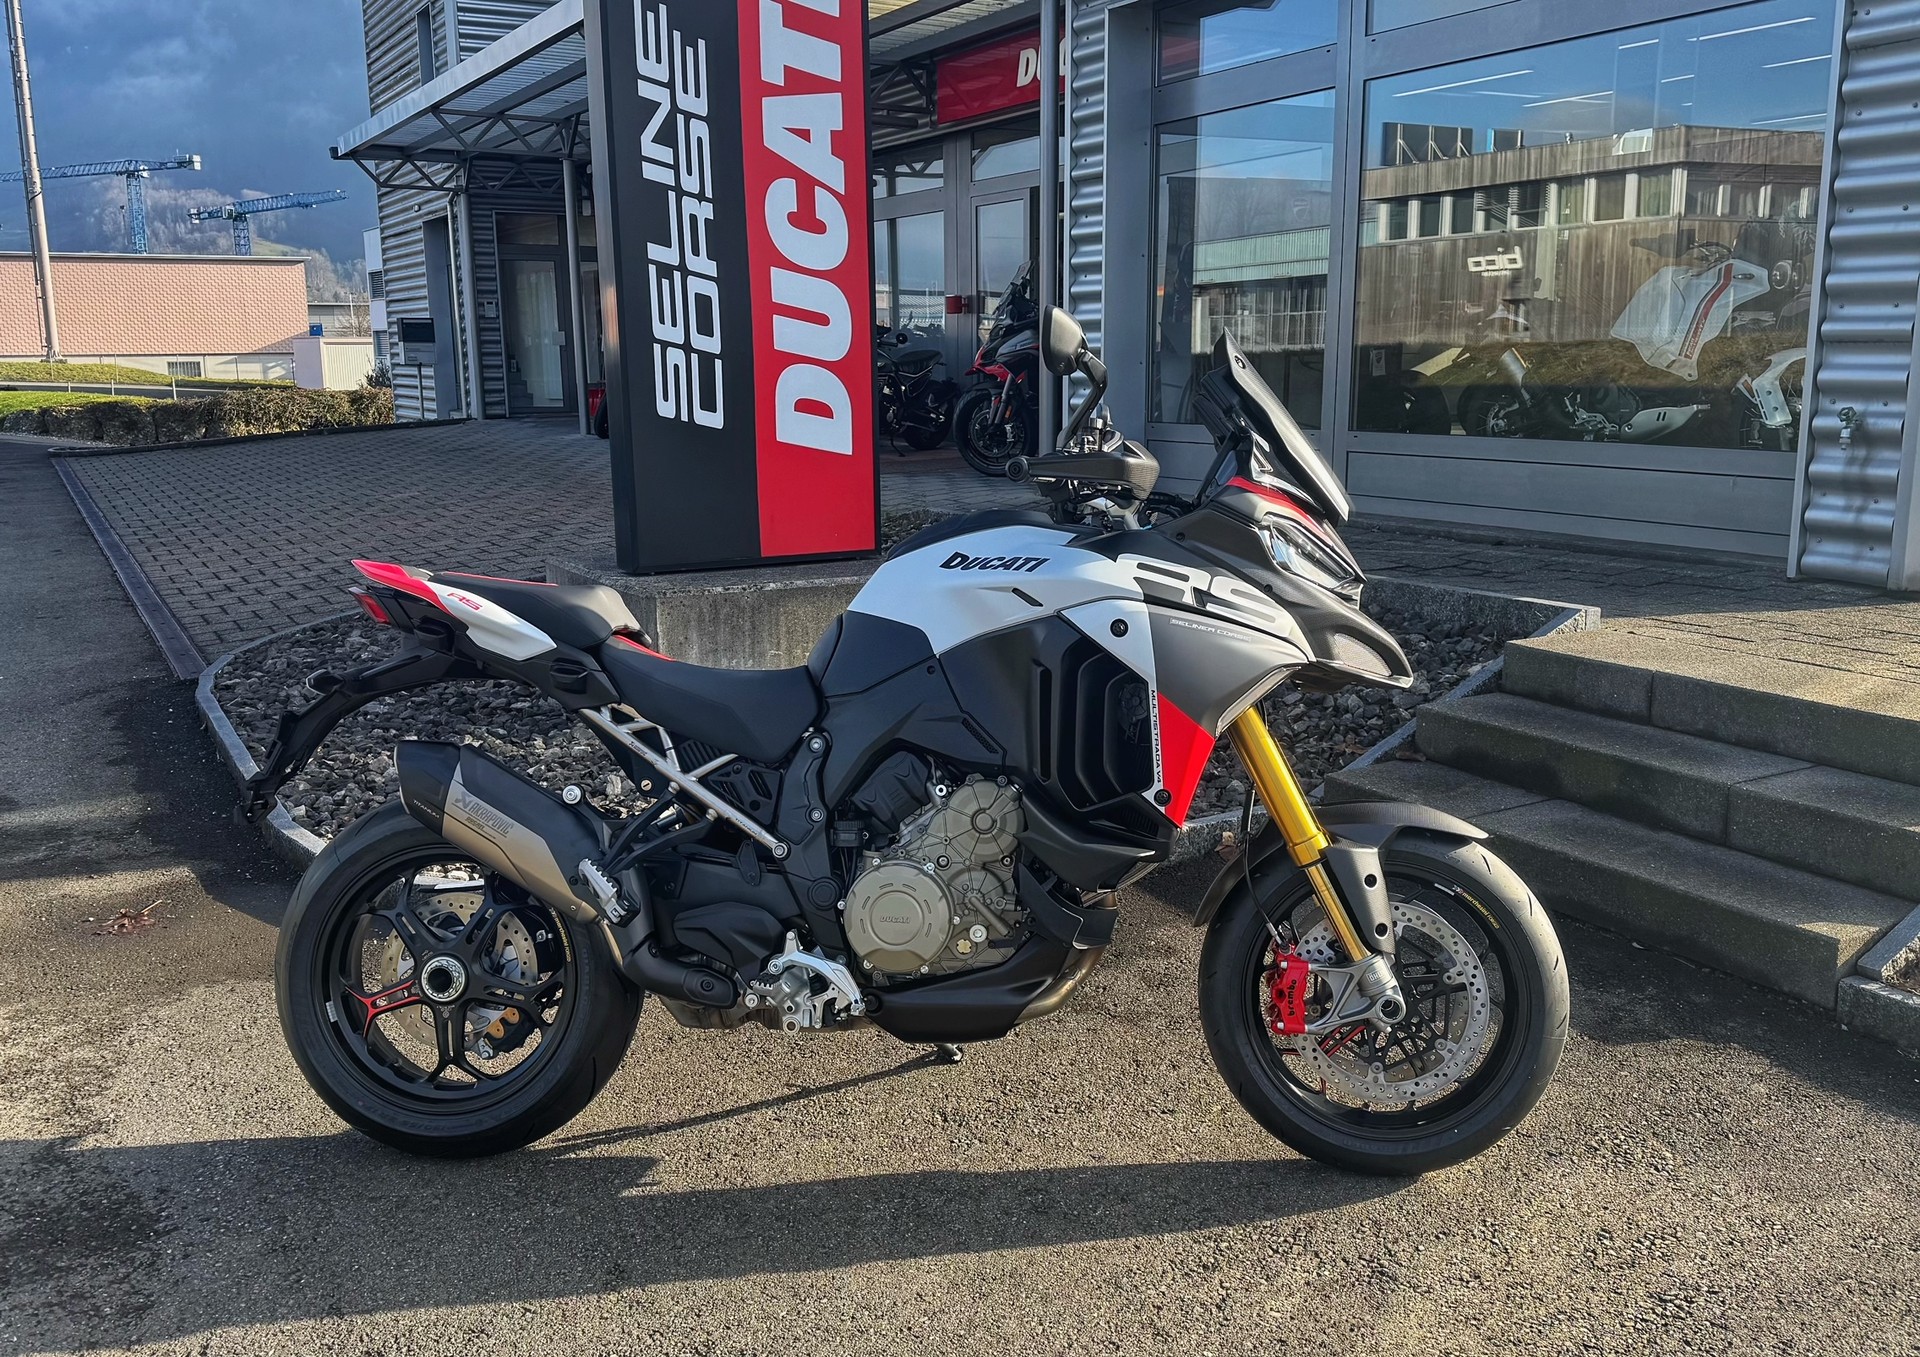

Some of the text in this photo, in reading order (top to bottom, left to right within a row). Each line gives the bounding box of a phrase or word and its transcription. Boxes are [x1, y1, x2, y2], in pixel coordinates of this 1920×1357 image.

[673, 30, 725, 430] CORSE
[757, 0, 853, 455] DUCAT
[939, 551, 1051, 573] DUCATI
[1170, 618, 1252, 642] SELINER CORSE
[1150, 689, 1162, 769] MULTISTRADA
[1286, 979, 1297, 1017] brembo
